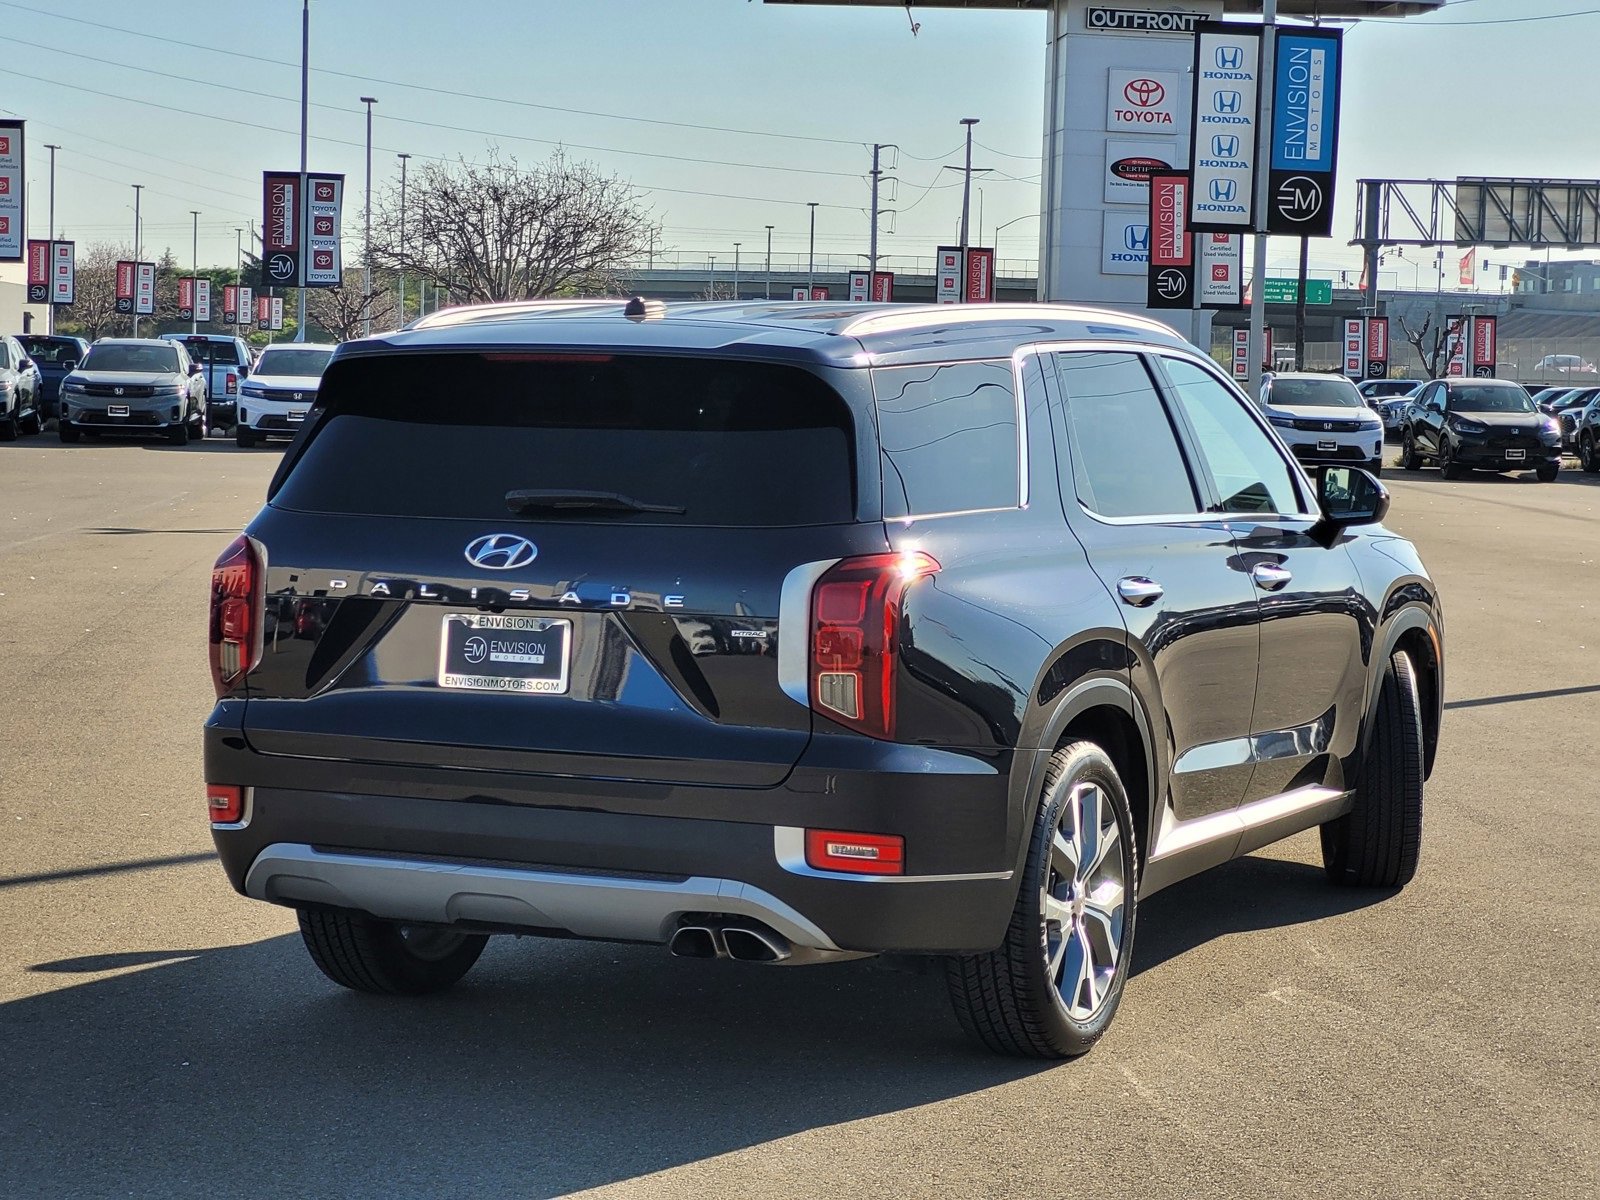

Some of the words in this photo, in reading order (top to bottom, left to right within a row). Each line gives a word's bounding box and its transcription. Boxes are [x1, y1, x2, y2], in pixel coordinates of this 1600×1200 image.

[1092, 10, 1199, 31] OUTFRONT
[1203, 72, 1253, 81] HONDA
[1285, 47, 1309, 160] ENVISION
[1309, 59, 1322, 151] MOTORS
[1115, 110, 1172, 124] TOYOTA
[1201, 116, 1251, 125] HONDA
[1199, 160, 1249, 169] HONDA
[272, 184, 284, 246] ENVISION
[1197, 204, 1247, 213] HONDA
[1160, 183, 1173, 259] ENVISION
[972, 255, 981, 299] ENVISION
[330, 579, 686, 607] PALISADE
[480, 616, 534, 629] ENVISION
[490, 640, 547, 655] ENVISION
[494, 654, 540, 662] MOTORS
[445, 676, 560, 691] ENVISIONMOTORS.COM
